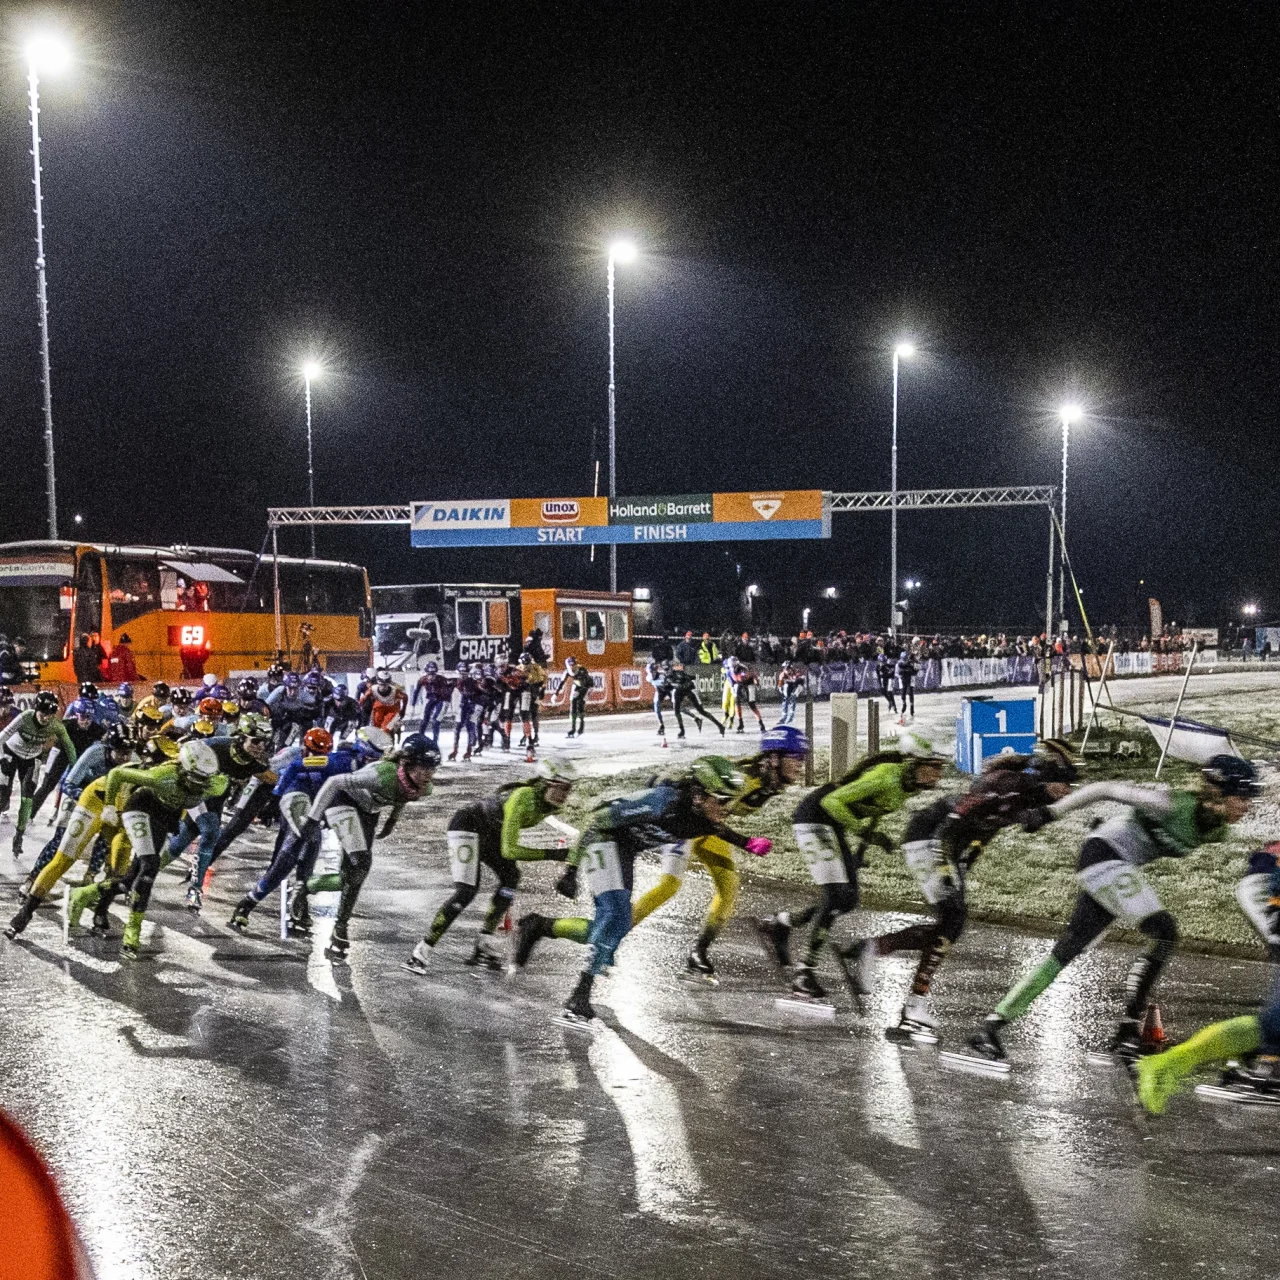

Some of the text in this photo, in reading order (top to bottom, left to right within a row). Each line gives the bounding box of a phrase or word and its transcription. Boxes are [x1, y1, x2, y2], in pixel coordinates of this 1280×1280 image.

[432, 507, 505, 522] DAIKIN
[609, 503, 657, 517] Holland
[667, 502, 711, 515] Barrett
[537, 527, 584, 542] START
[634, 525, 687, 540] FINISH
[181, 625, 204, 645] 69
[459, 639, 501, 661] CRAFT
[994, 709, 1007, 733] 1
